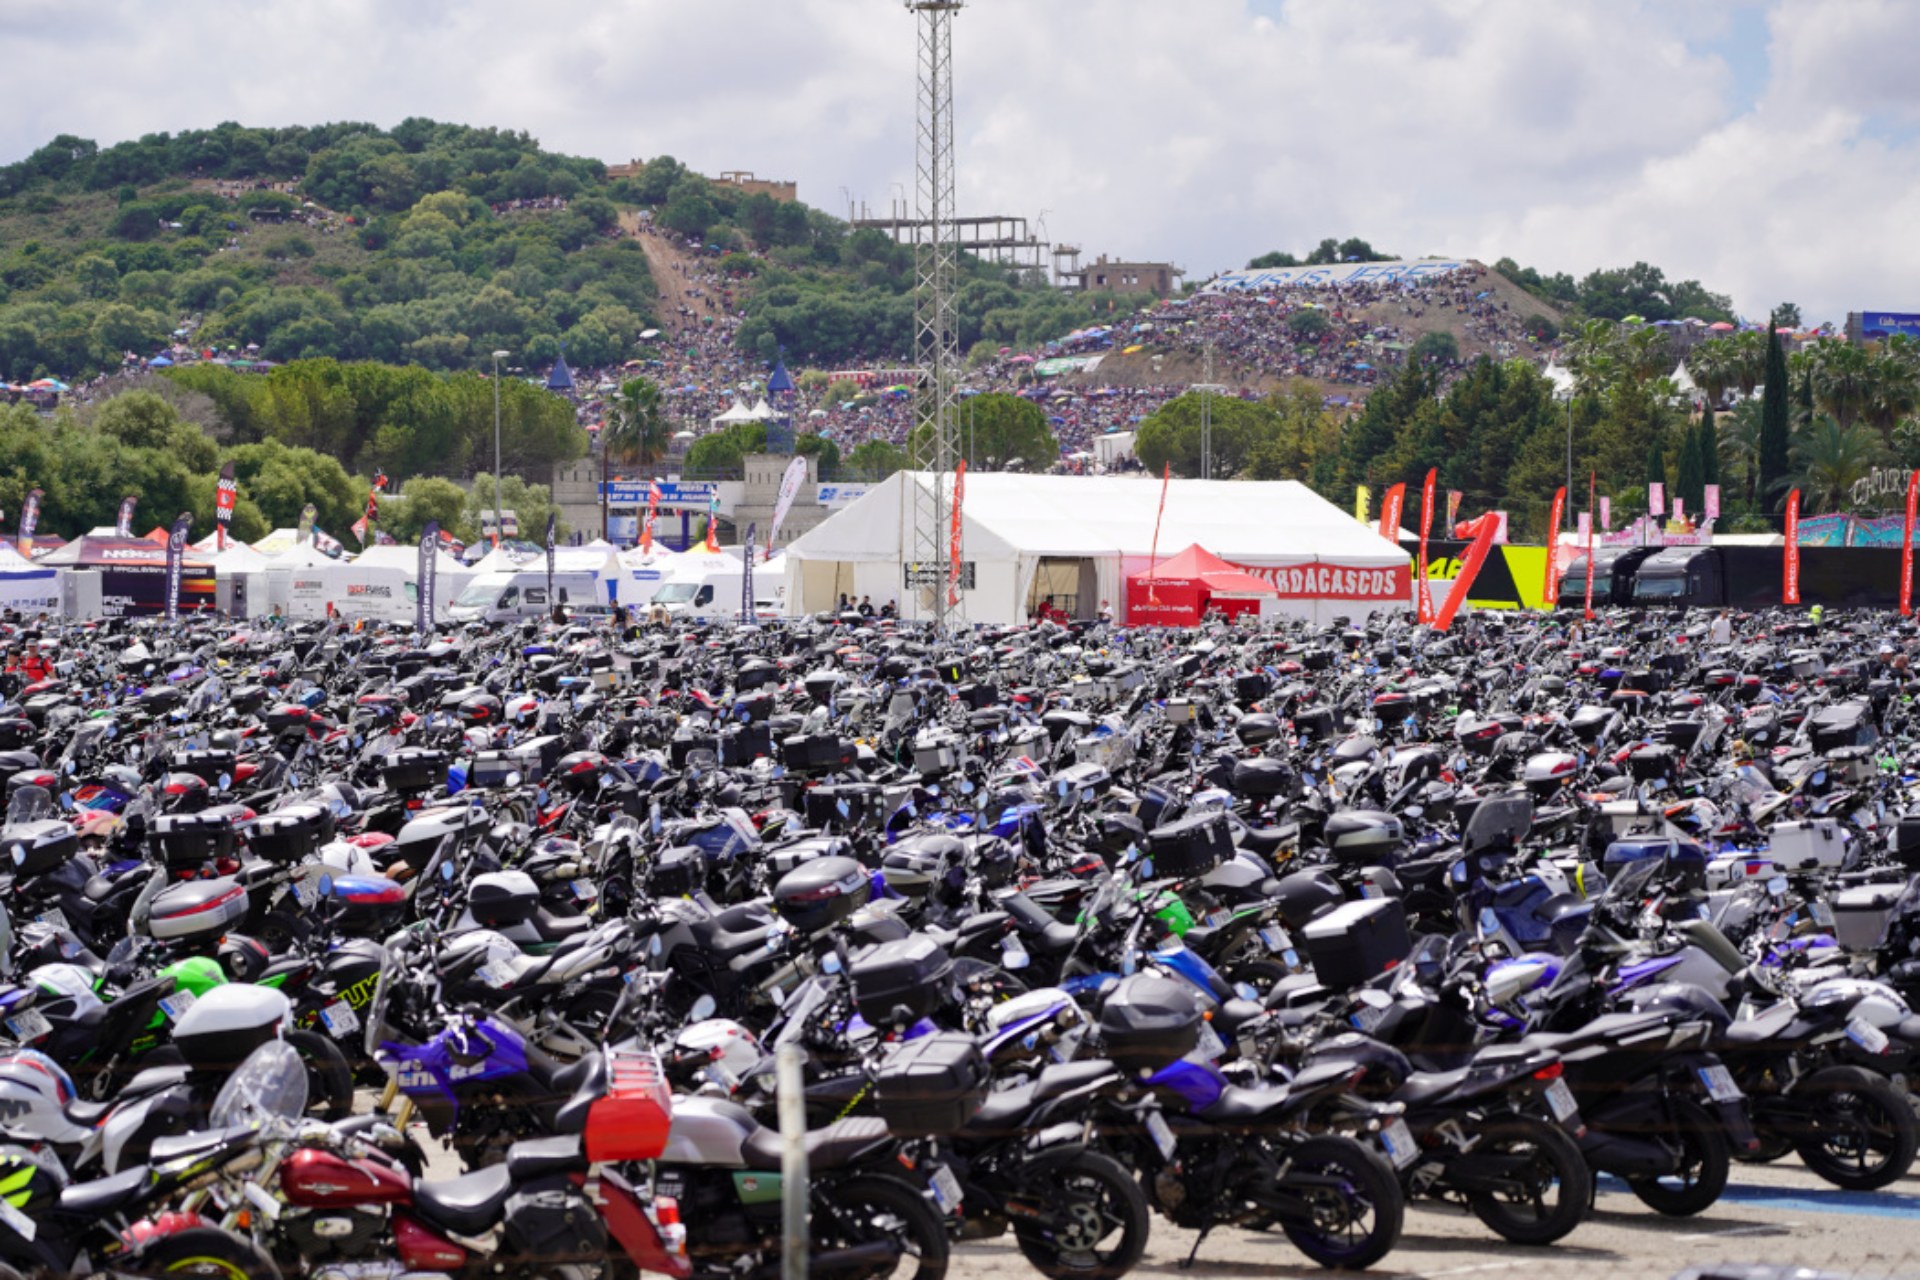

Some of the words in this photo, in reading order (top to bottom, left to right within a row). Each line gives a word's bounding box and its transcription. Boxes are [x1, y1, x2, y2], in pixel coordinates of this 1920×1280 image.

[169, 553, 180, 620] ardacascos
[422, 558, 433, 626] ardacascos
[1238, 567, 1396, 595] ARDACASCOS
